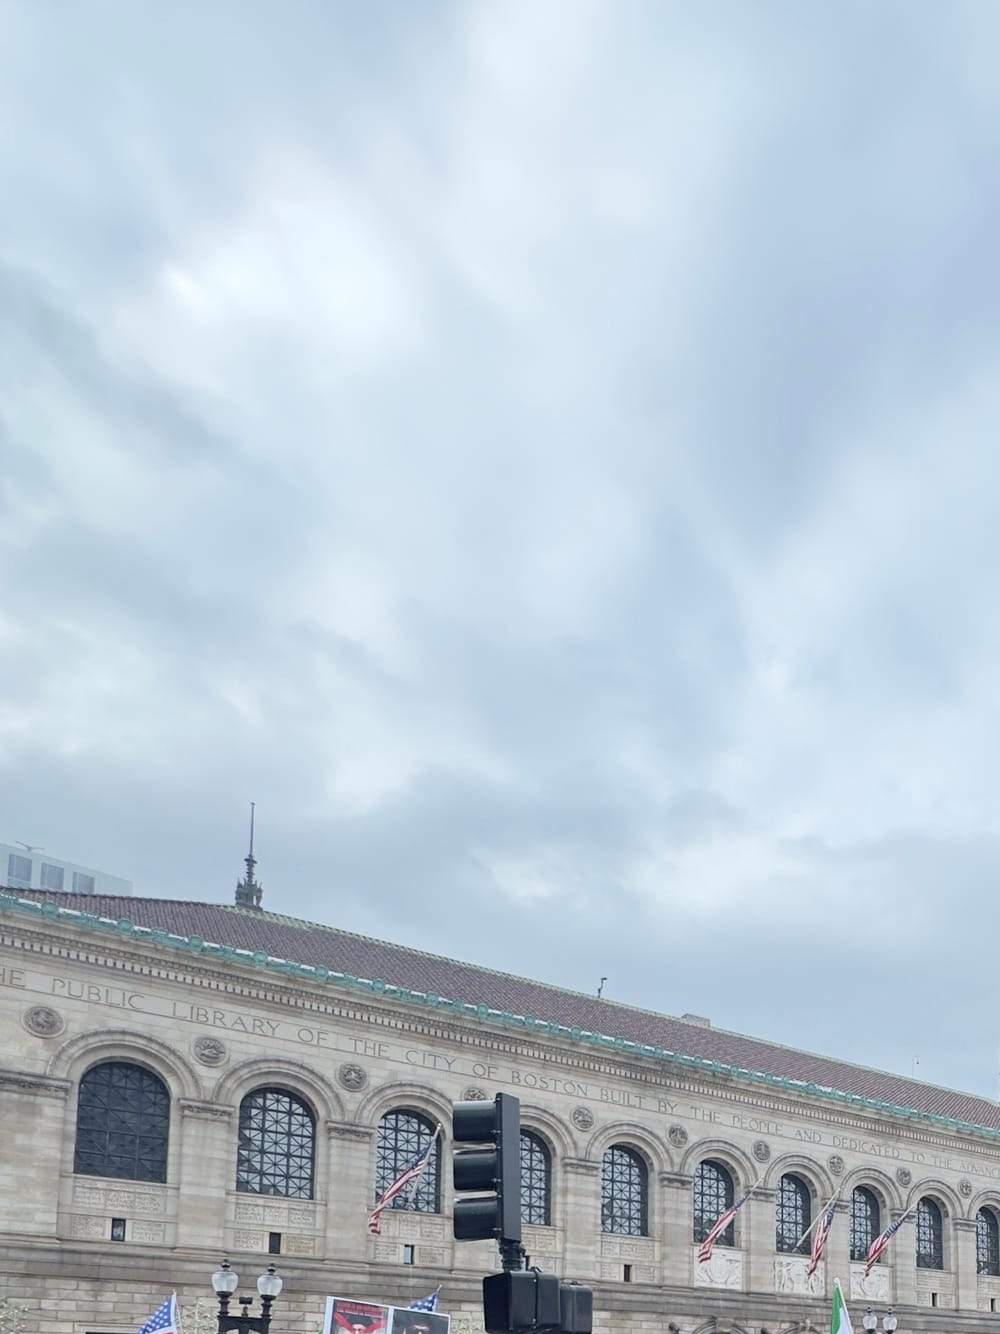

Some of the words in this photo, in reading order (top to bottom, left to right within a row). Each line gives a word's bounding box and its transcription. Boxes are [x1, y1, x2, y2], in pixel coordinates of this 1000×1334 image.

[51, 978, 144, 1009] PUBLIC
[172, 1002, 281, 1036] LIBRARY
[297, 1028, 329, 1044] OF
[349, 1038, 391, 1058] THE
[404, 1050, 456, 1071] CITY
[472, 1063, 500, 1079] OF
[511, 1070, 588, 1097] BOSTON
[600, 1088, 644, 1107] BUILT
[658, 1100, 678, 1114] BY
[690, 1106, 721, 1123] THE
[732, 1115, 783, 1135] PEOPLE
[794, 1129, 822, 1143] AND
[832, 1135, 900, 1158] DEDICATED
[911, 1151, 925, 1161] TO
